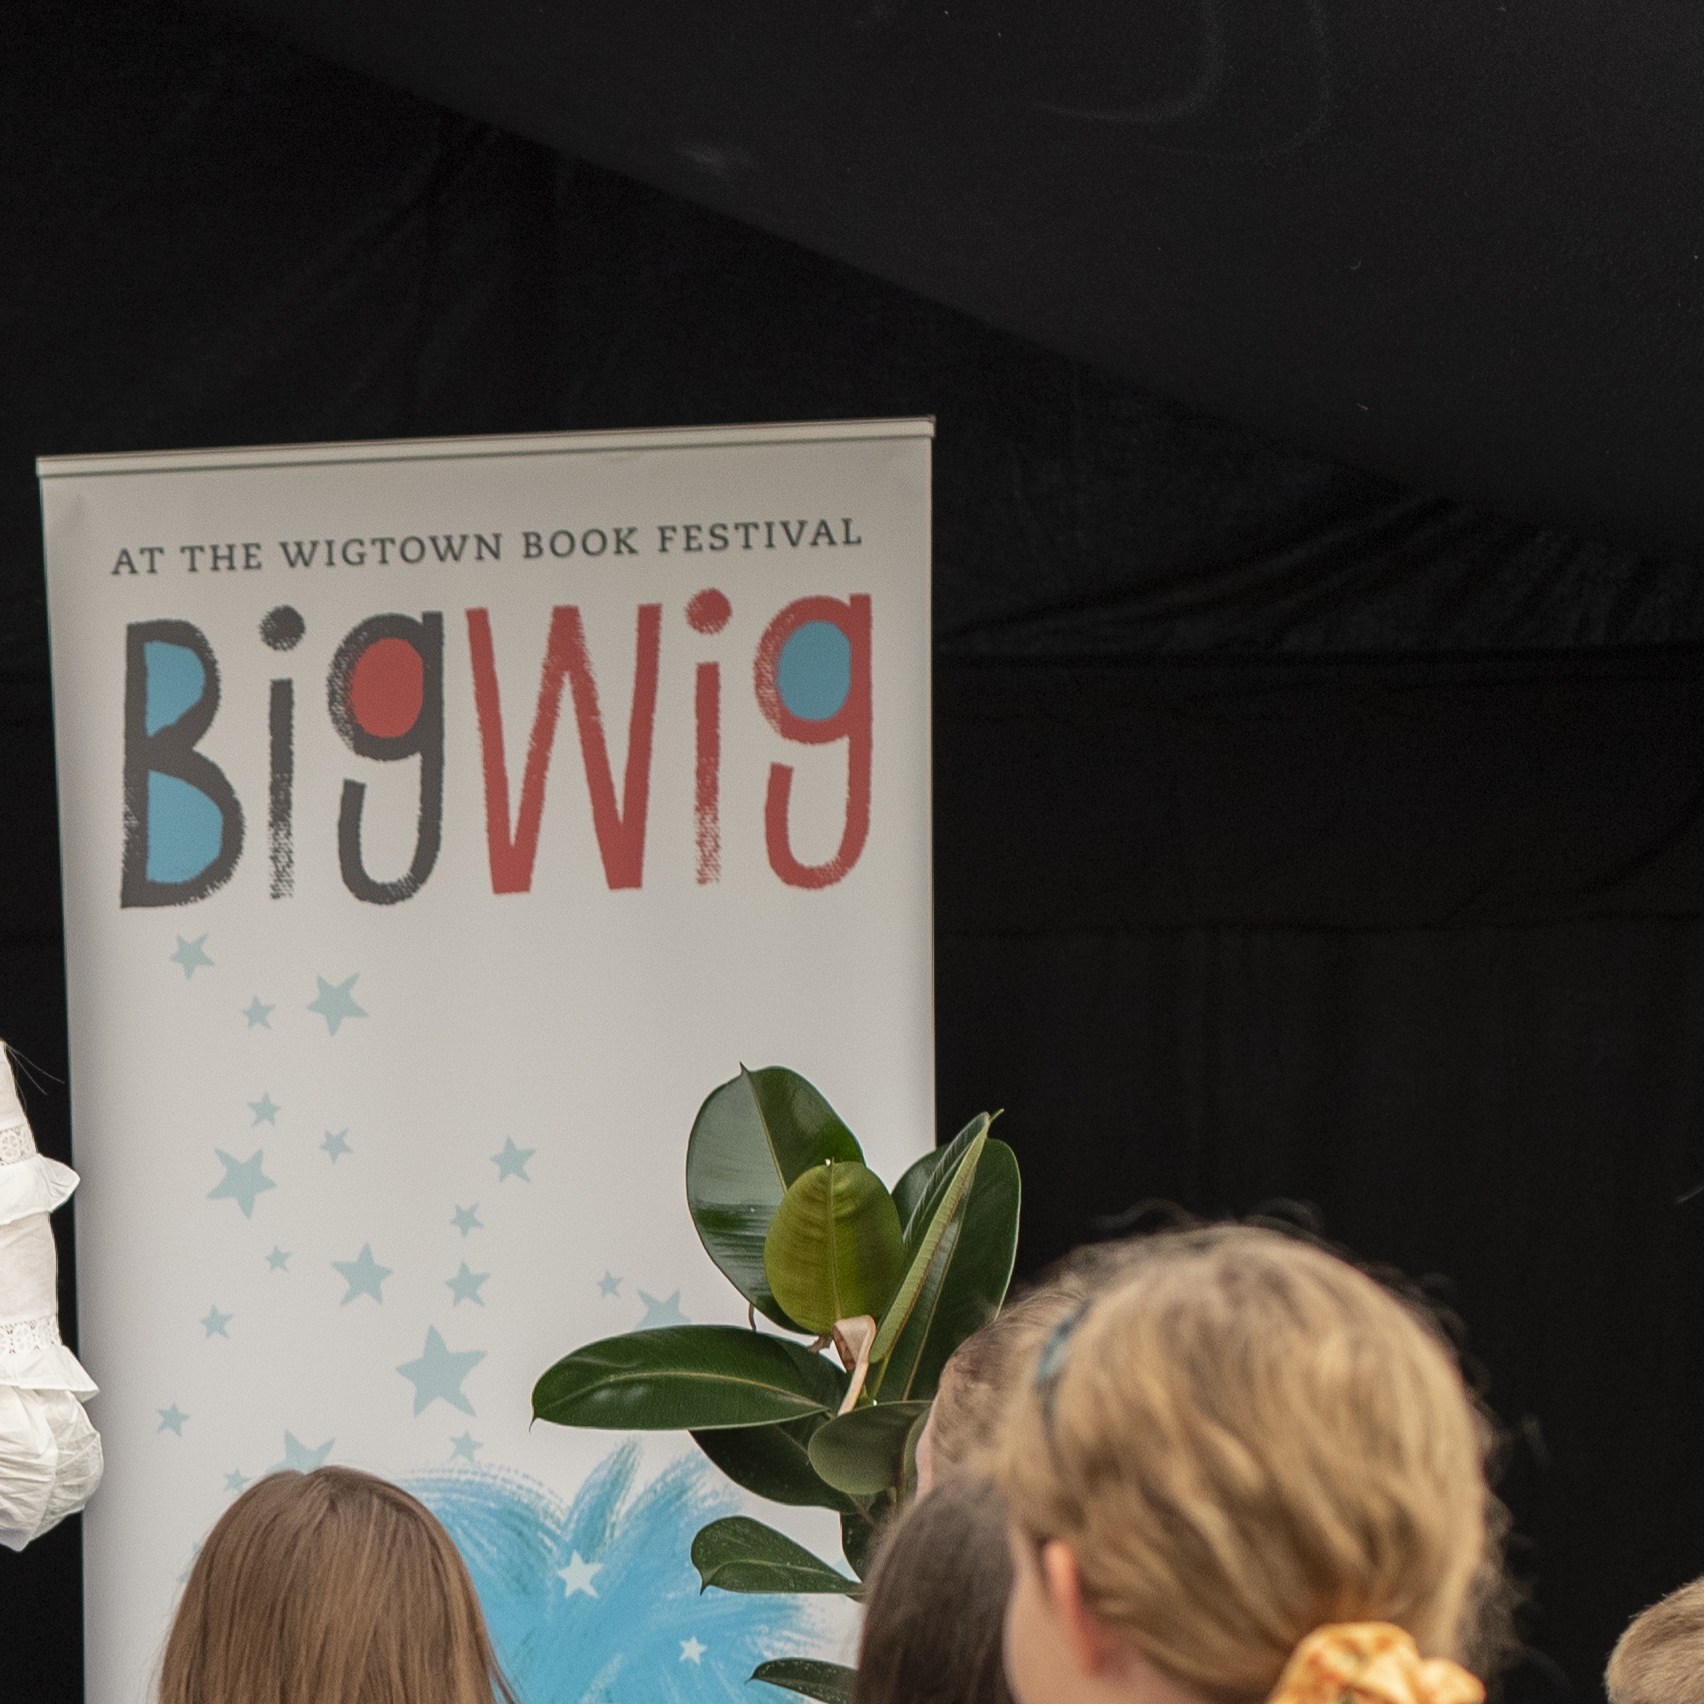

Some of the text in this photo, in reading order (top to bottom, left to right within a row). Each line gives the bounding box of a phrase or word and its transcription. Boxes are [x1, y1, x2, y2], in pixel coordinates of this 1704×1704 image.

[111, 518, 863, 577] AT THE WIGTOWN BOOK FESTIVAL
